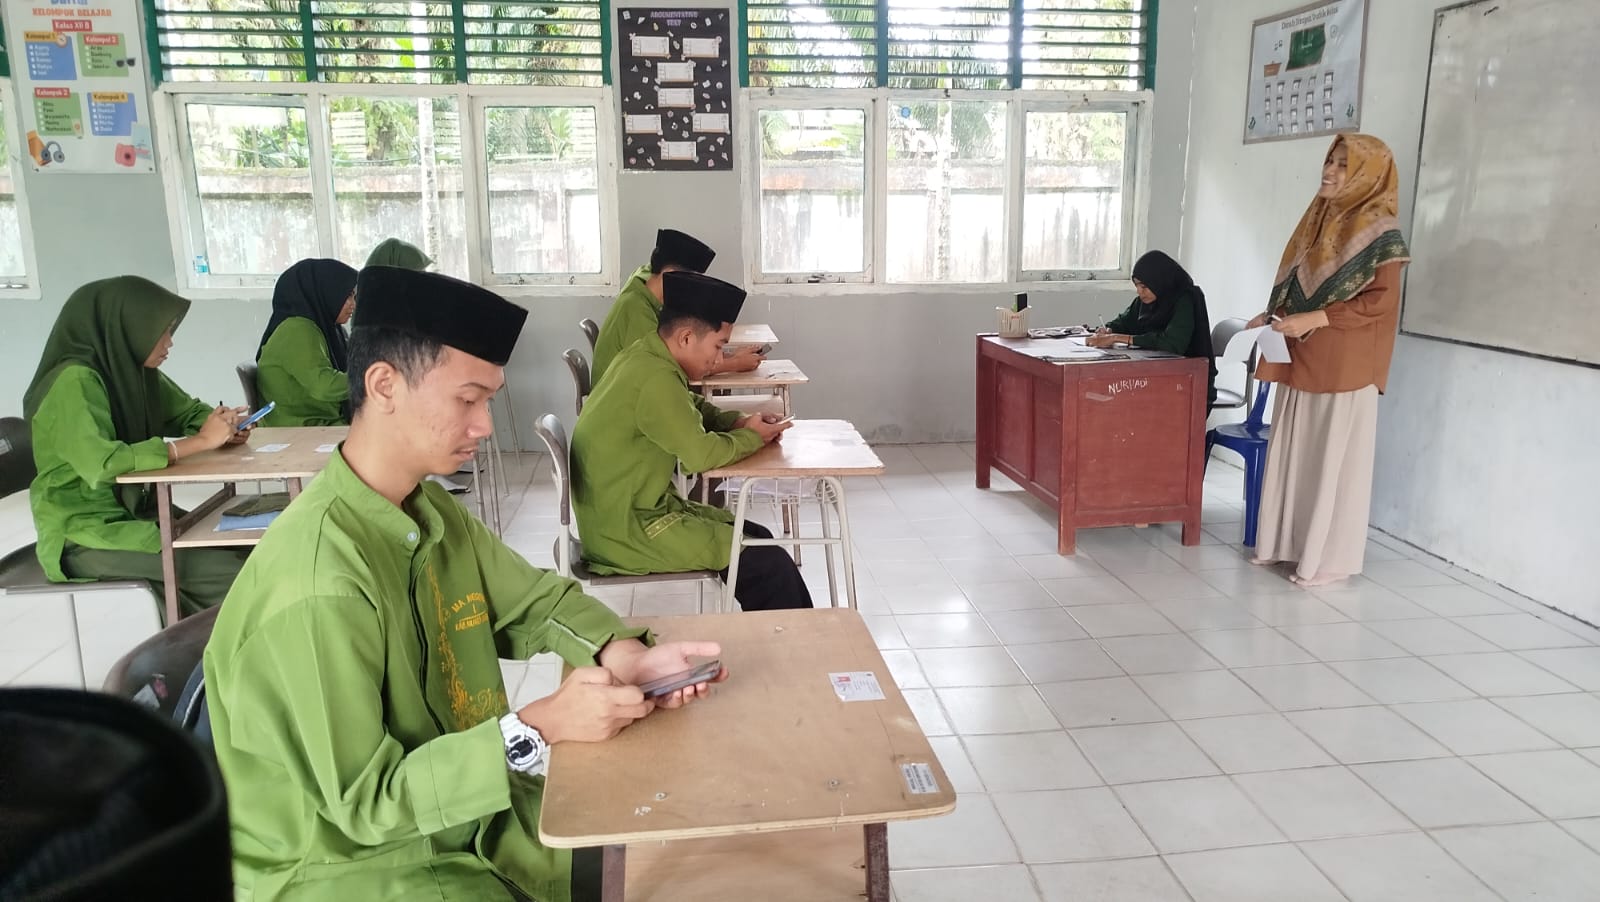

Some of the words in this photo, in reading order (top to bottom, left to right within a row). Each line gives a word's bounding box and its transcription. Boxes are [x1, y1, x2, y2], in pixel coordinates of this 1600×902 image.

[32, 8, 74, 16] KELOMPOK
[78, 8, 112, 16] BELAJAR
[55, 21, 73, 30] Kelas
